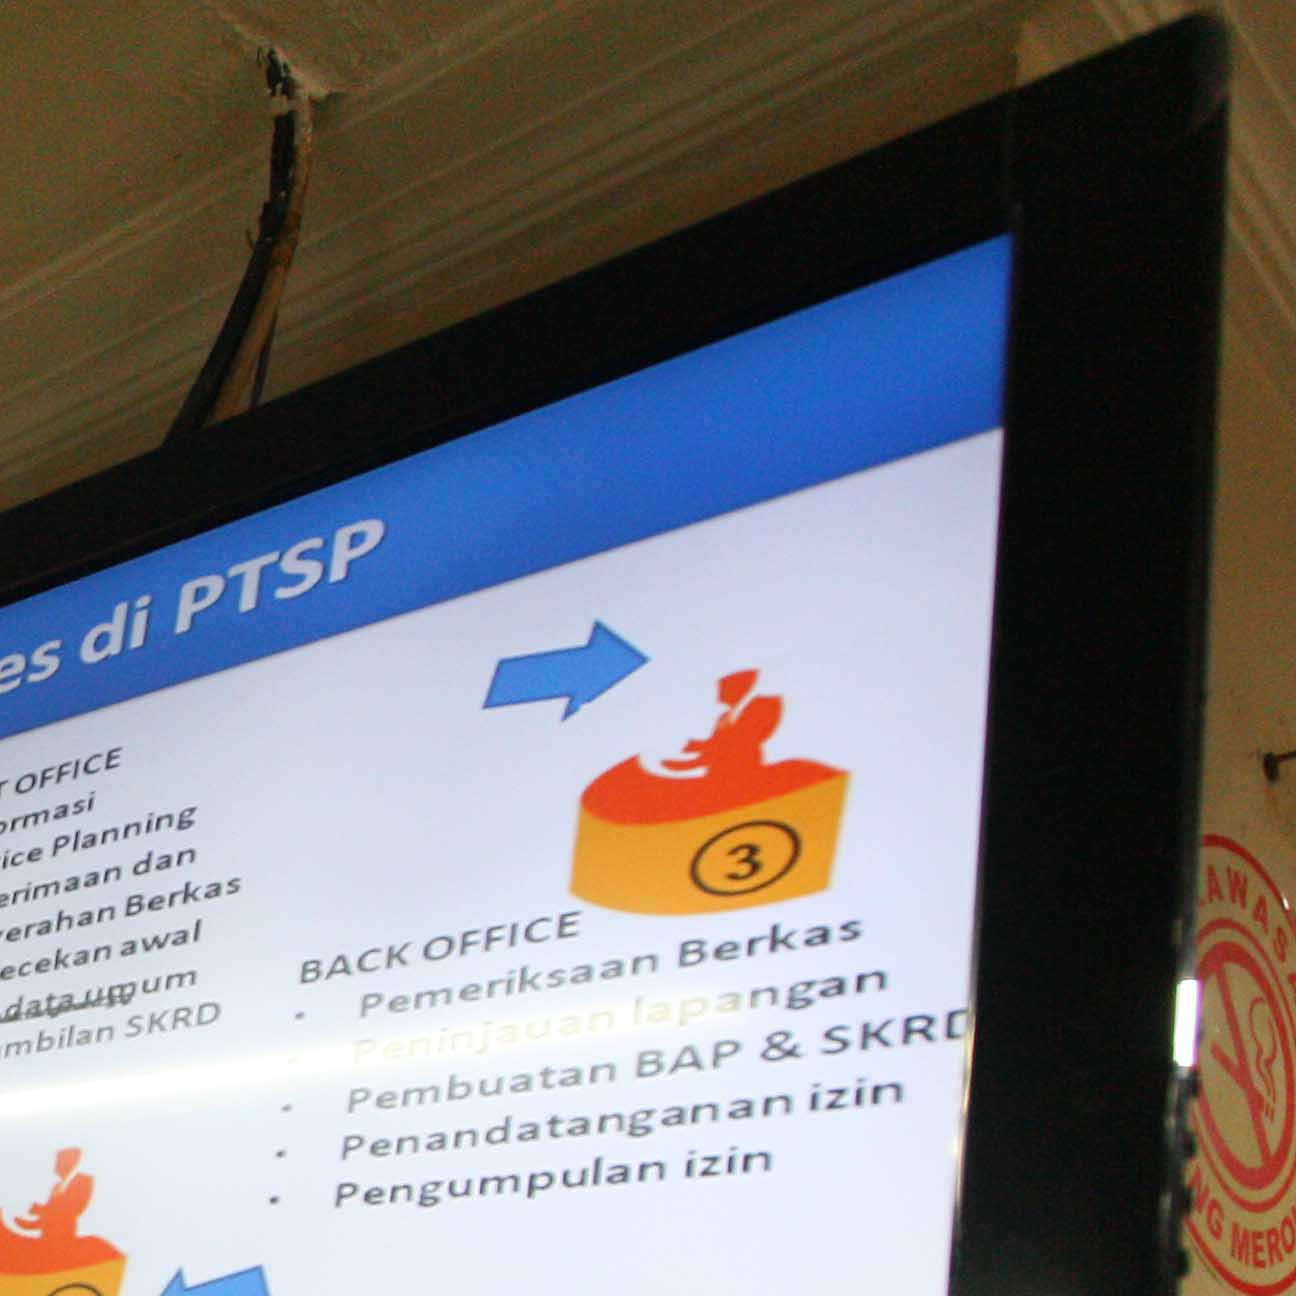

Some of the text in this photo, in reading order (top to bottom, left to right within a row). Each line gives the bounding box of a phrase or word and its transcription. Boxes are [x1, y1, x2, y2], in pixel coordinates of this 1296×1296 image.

[79, 595, 153, 664] di
[174, 519, 386, 636] PTSP
[14, 747, 124, 795] OFFICE
[52, 805, 198, 857] Planning
[132, 846, 197, 877] dan
[725, 843, 763, 881] 3
[124, 877, 242, 919] Berkas
[120, 920, 203, 960] awal
[298, 909, 584, 986] BACK OFFICE
[359, 917, 864, 1019] Pemeriksaan Berkas
[0, 993, 74, 1023] data
[123, 1001, 222, 1038] SKRD
[352, 968, 889, 1063] Peninjauan lapangan
[346, 1060, 617, 1115] Pembuatan
[634, 1037, 744, 1079] BAP
[759, 1029, 805, 1064] &
[340, 1076, 905, 1161] Penandatanganan izin
[334, 1147, 774, 1209] Pengumpulan izin
